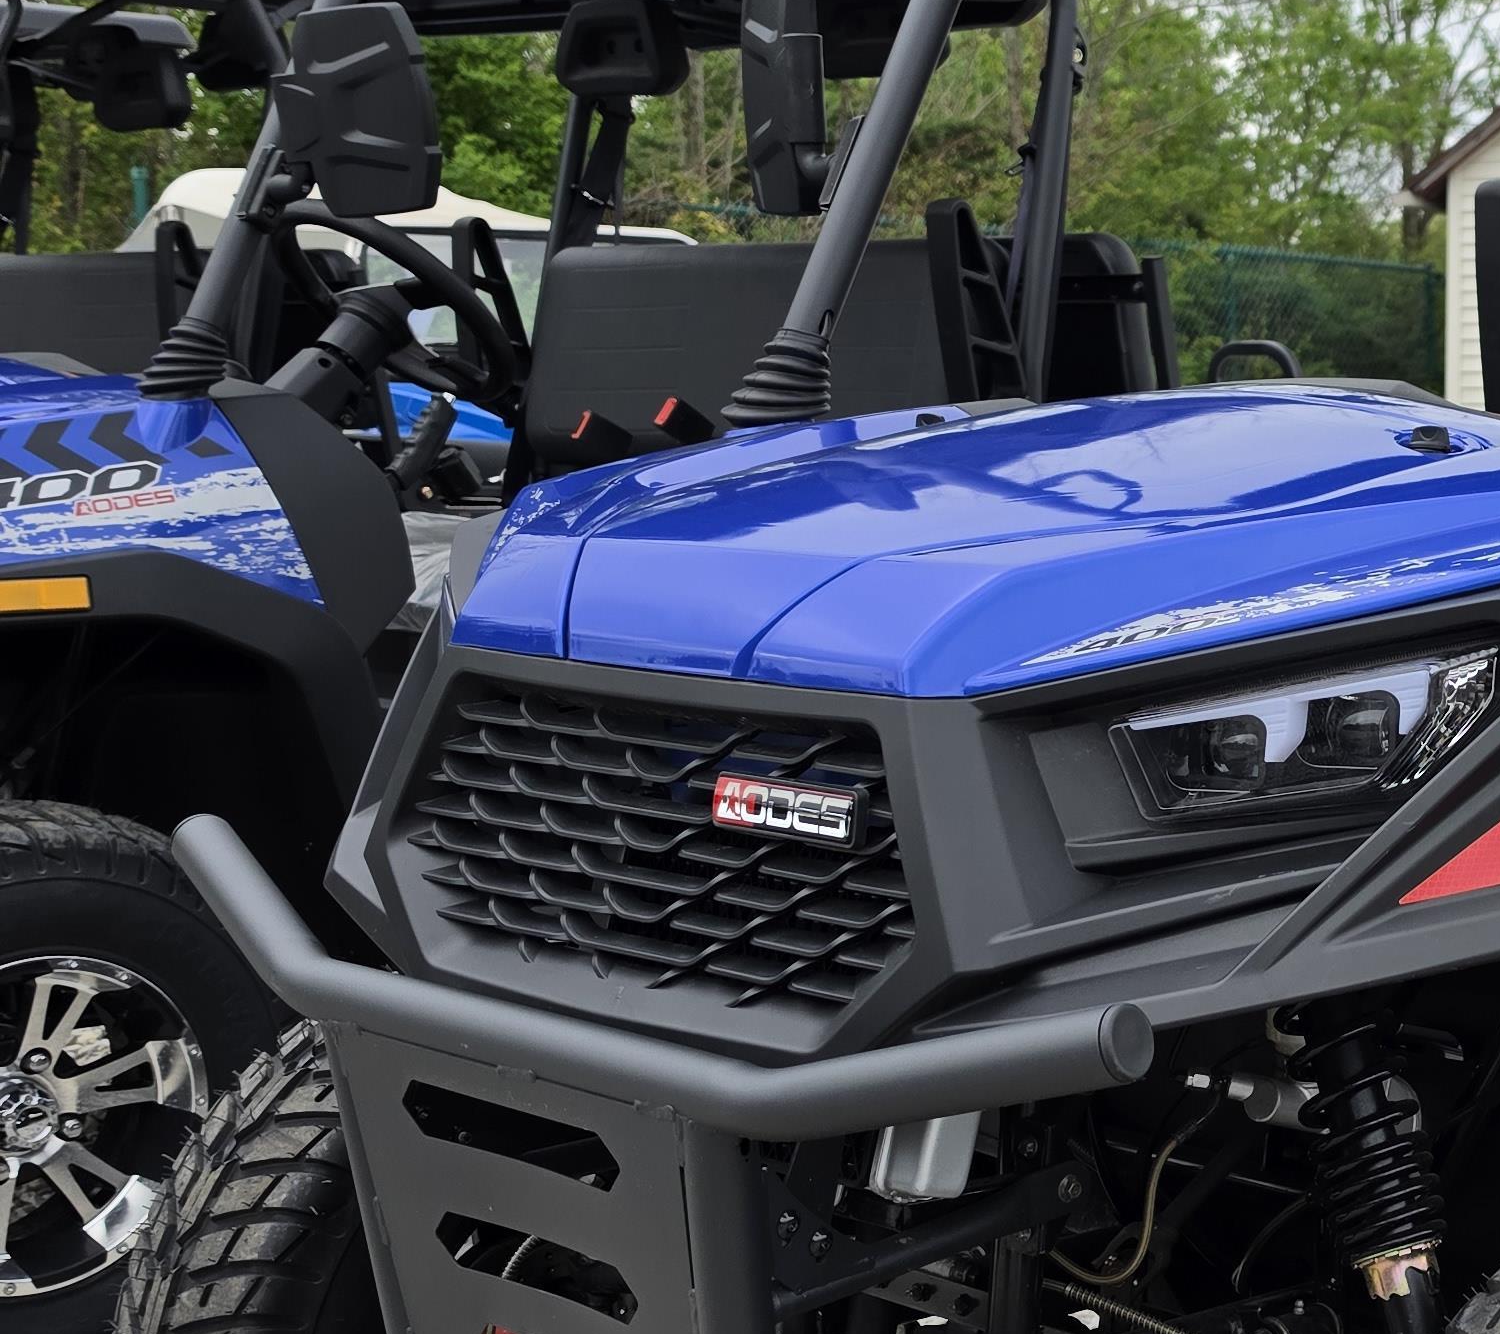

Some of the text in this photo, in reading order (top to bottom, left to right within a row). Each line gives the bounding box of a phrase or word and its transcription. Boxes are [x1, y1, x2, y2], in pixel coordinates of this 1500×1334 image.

[0, 460, 162, 511] 00
[74, 489, 175, 516] AODES
[1074, 617, 1219, 653] 400
[717, 781, 853, 839] AODES
